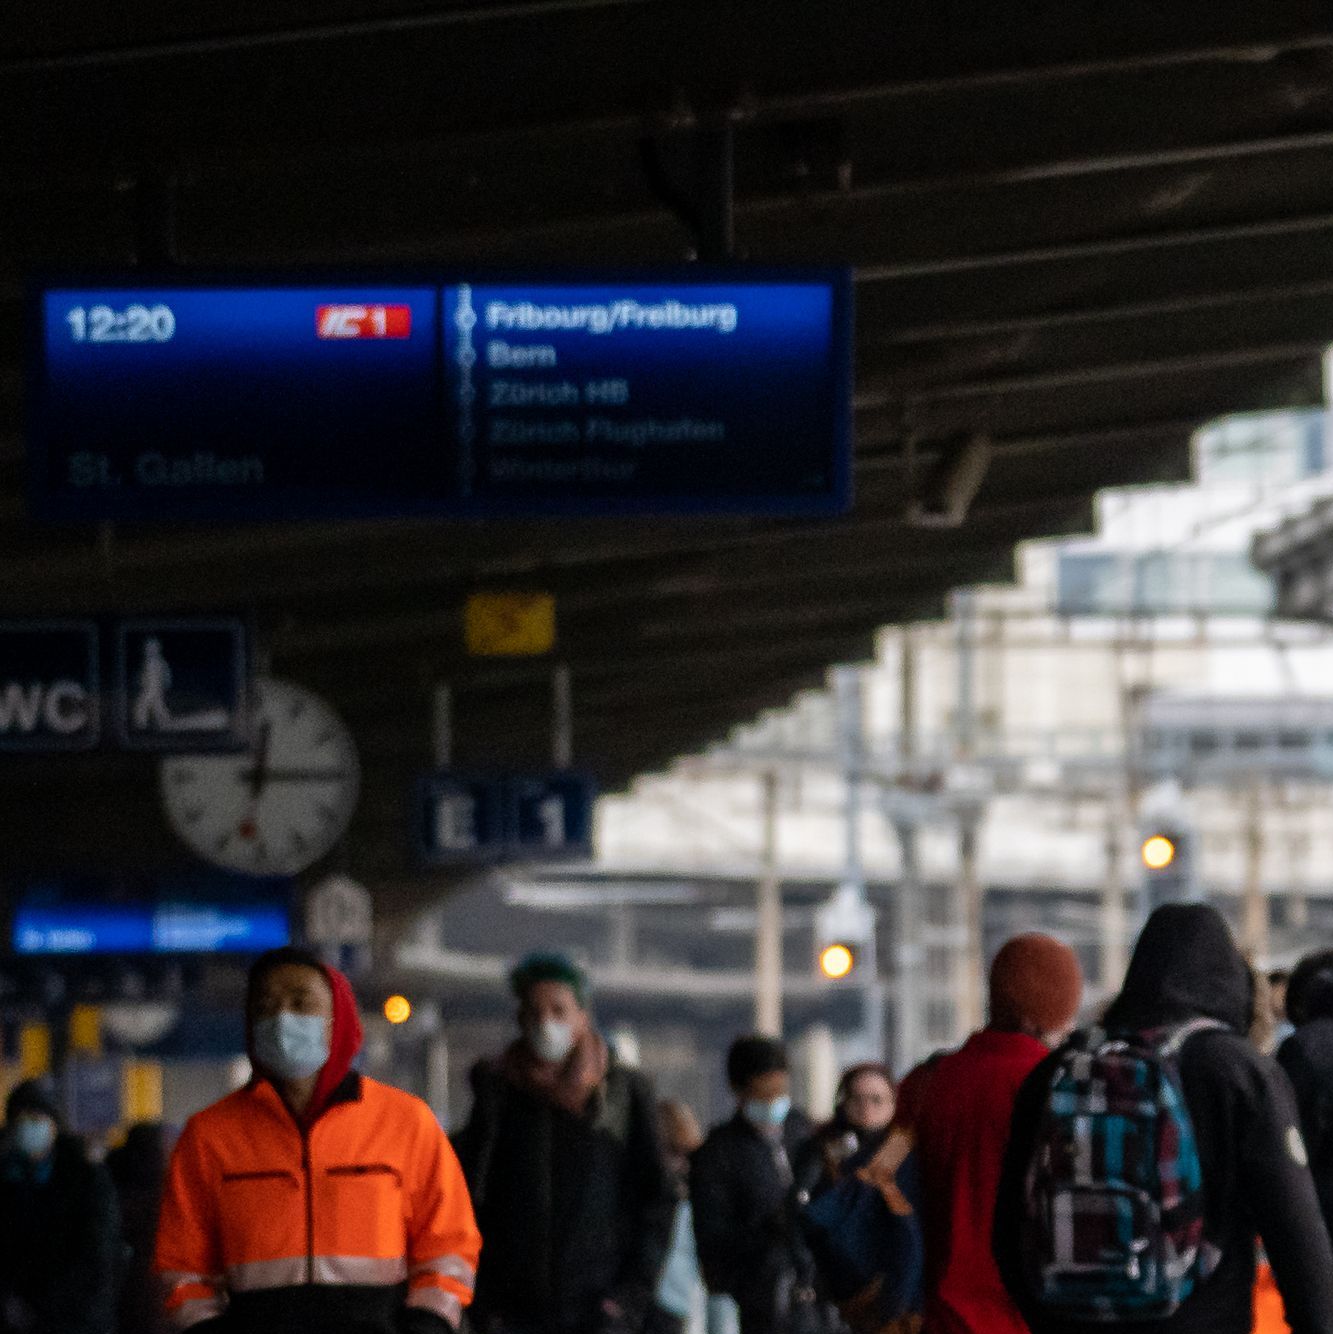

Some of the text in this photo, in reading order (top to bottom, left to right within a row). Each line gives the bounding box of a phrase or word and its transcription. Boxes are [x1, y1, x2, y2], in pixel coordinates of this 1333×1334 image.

[68, 306, 176, 342] 12:20
[485, 300, 737, 333] Fribourg/Freiburg
[486, 339, 556, 368] Bern
[0, 679, 87, 733] WC
